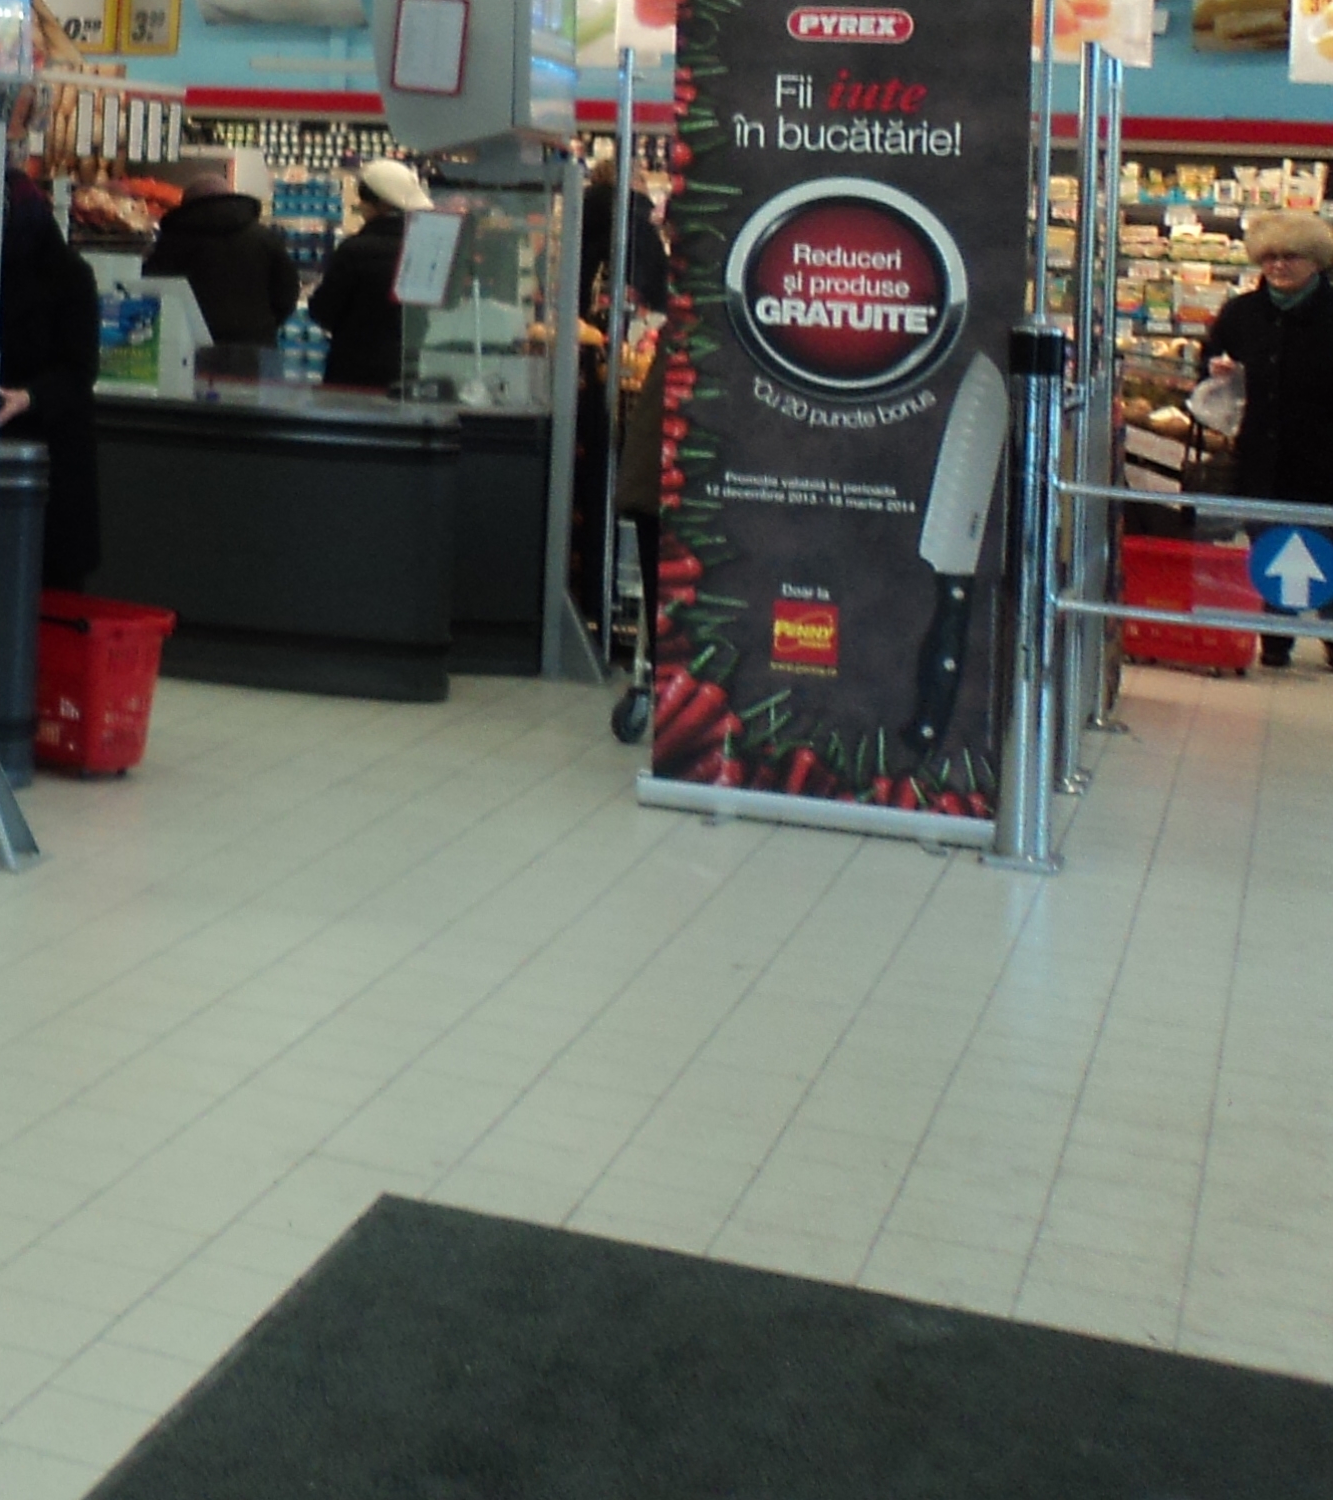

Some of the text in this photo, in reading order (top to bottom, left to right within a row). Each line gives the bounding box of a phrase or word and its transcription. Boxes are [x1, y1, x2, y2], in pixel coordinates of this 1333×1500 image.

[775, 66, 928, 115] Fii iute
[733, 112, 962, 158] în bucătărie!
[792, 242, 902, 271] Reduceri
[809, 274, 911, 299] produse
[781, 396, 808, 422] 20
[809, 408, 877, 430] puncte
[876, 389, 937, 426] bonus
